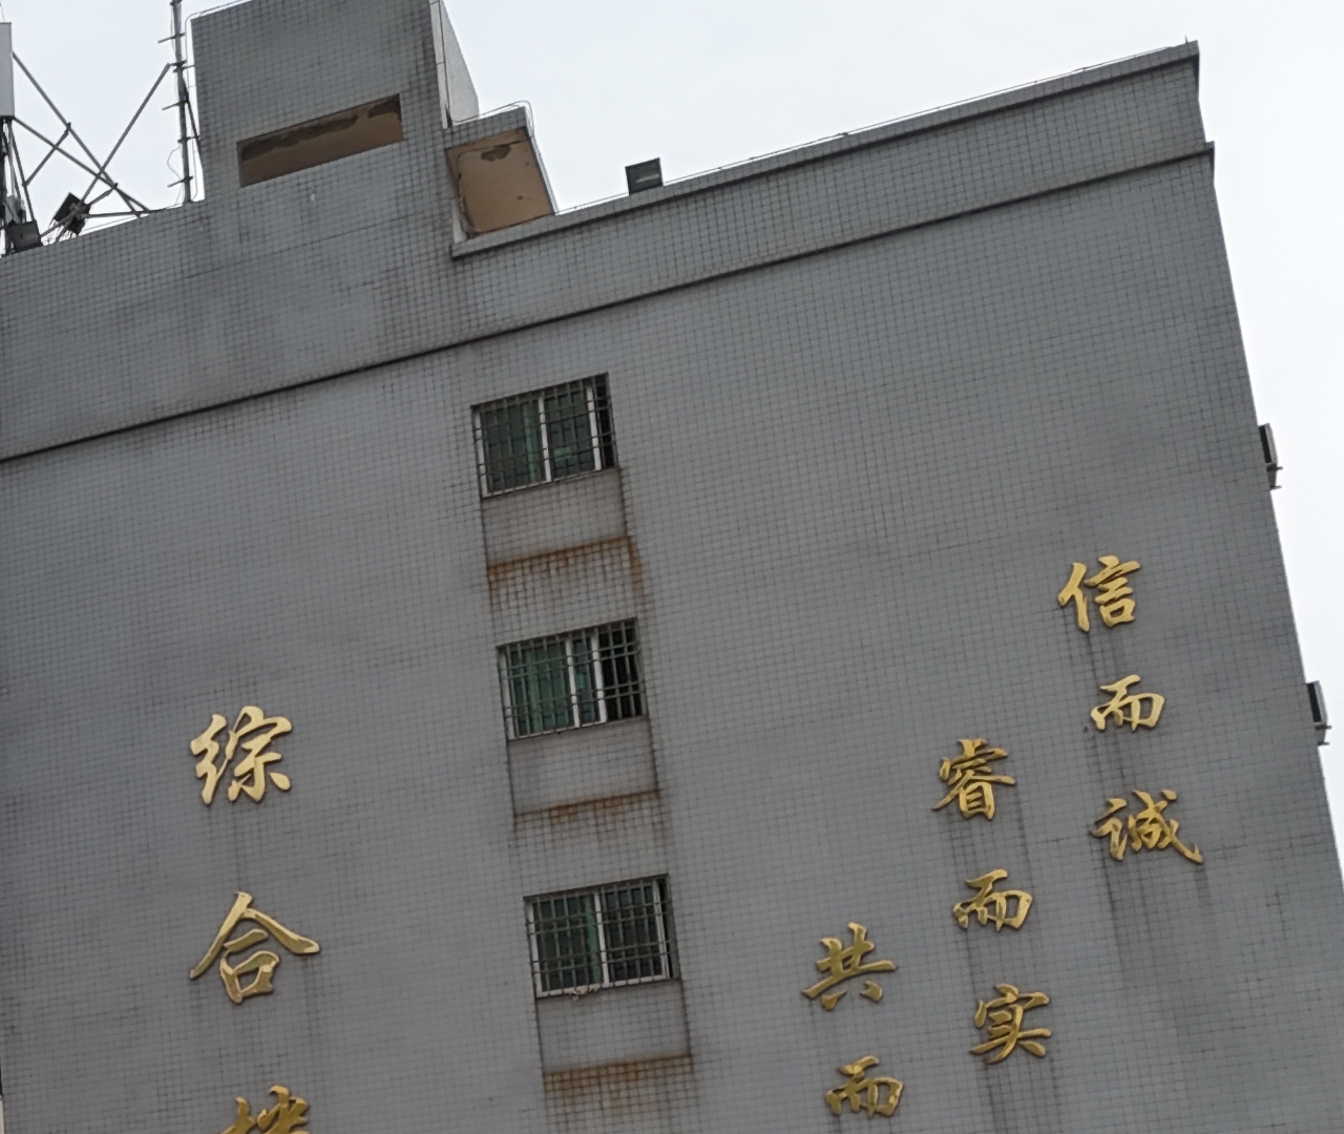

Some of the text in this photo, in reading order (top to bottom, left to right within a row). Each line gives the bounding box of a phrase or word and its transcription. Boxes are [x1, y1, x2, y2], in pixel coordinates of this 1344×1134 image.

[1058, 555, 1204, 864] 信而诚
[933, 737, 1053, 1064] 睿而实
